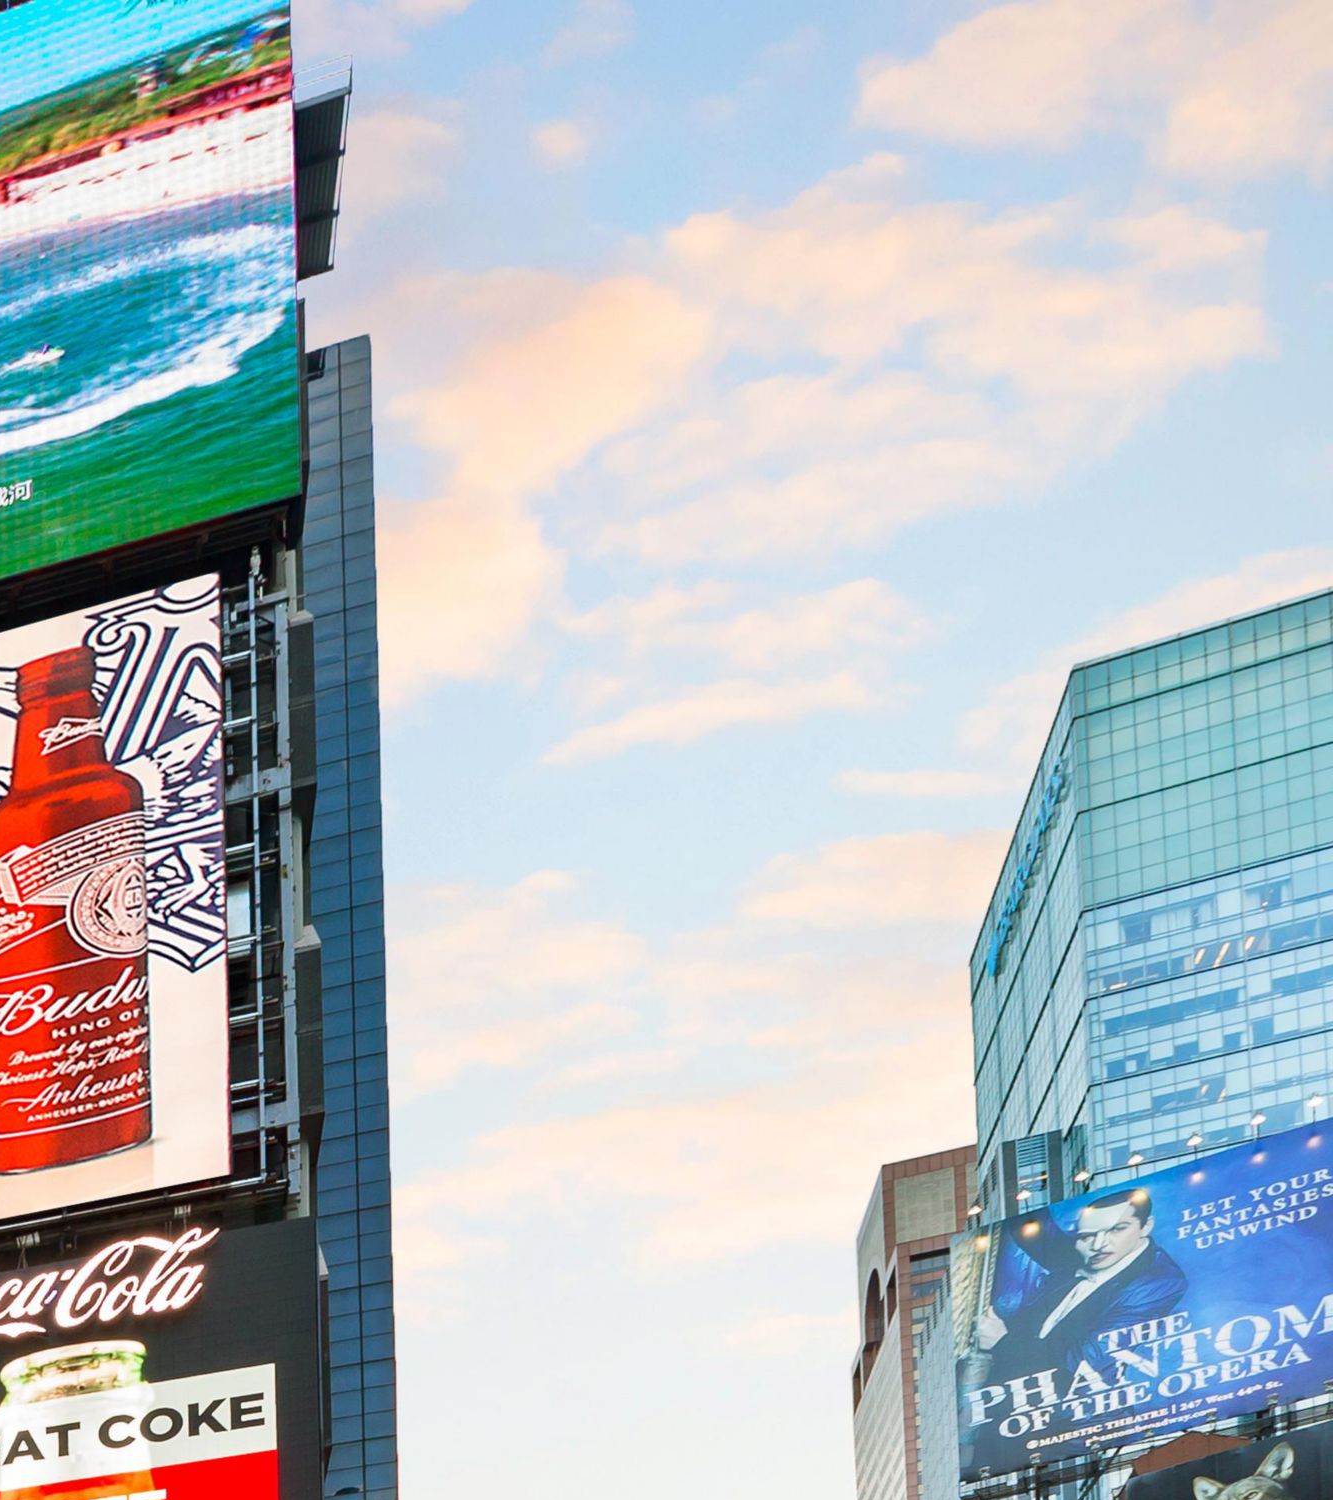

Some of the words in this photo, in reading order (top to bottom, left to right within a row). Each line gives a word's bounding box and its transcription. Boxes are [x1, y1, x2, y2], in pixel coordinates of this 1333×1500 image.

[52, 1017, 112, 1039] KING
[119, 1007, 142, 1022] OF
[7, 1044, 64, 1066] Brewed
[67, 1040, 88, 1058] by
[1177, 1183, 1333, 1241] FANTASIES
[1182, 1195, 1236, 1223] LET
[1247, 1167, 1332, 1201] YOUR
[1195, 1206, 1318, 1250] UNWIND
[1098, 1311, 1192, 1354] THE
[964, 1293, 1333, 1426] PHANTOM
[999, 1407, 1055, 1438] OF
[1062, 1381, 1152, 1423] THE
[1158, 1343, 1312, 1398] OPERA
[98, 1391, 265, 1446] COKE
[1109, 1406, 1168, 1430] THEATRE
